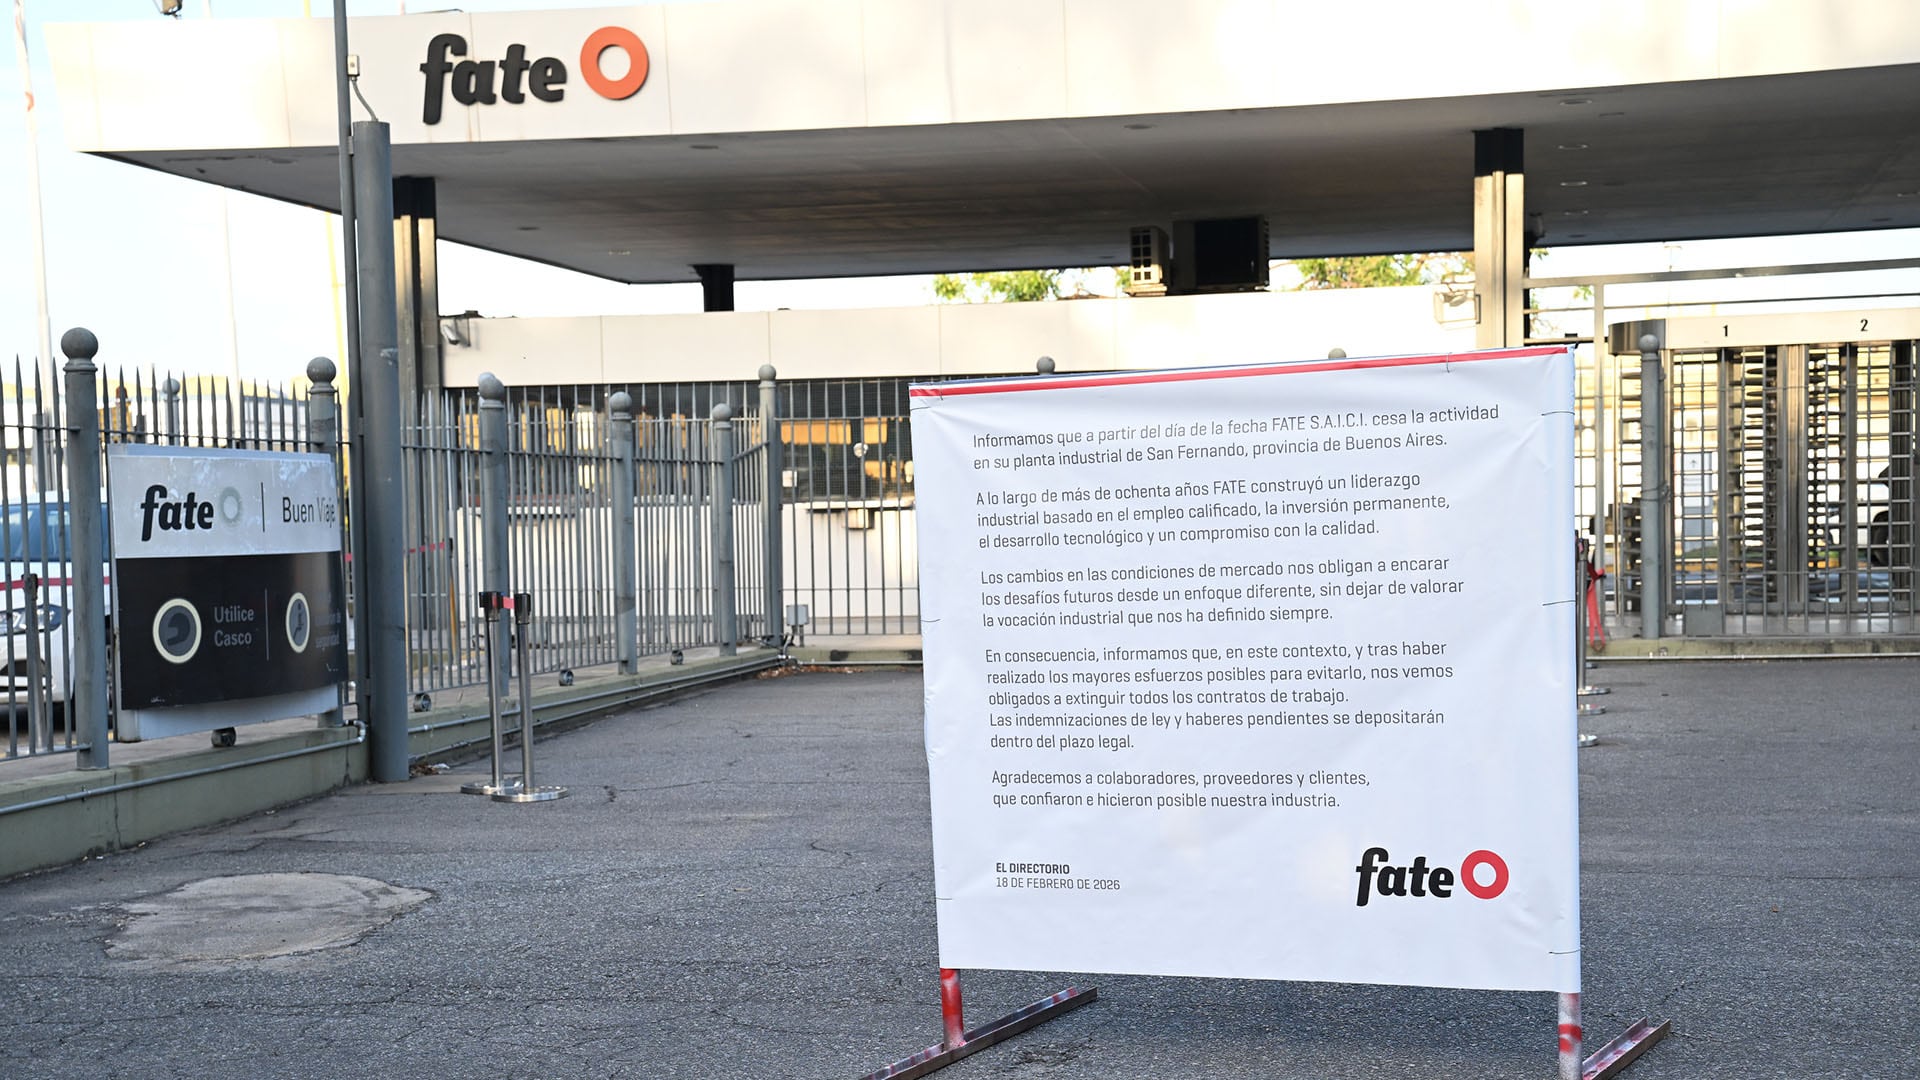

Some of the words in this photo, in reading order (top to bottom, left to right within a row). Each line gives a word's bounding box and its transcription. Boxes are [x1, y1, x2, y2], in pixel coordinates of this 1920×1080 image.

[420, 33, 567, 125] fate
[1722, 324, 1729, 337] 1
[1860, 319, 1869, 332] 2
[973, 433, 1054, 448] Informamos
[1057, 432, 1082, 447] que
[1086, 431, 1094, 442] a
[1098, 426, 1136, 445] partir
[1140, 424, 1160, 439] del
[1165, 423, 1186, 438] día
[1190, 422, 1207, 436] de
[1211, 421, 1223, 435] la
[1228, 418, 1268, 434] fecha
[1272, 416, 1305, 432] FATE
[1310, 412, 1368, 430] S.A.I.C.I.
[1372, 413, 1407, 426] cesa
[1411, 409, 1424, 424] la
[1429, 404, 1499, 423] actividad
[974, 458, 990, 470] en
[994, 458, 1010, 469] su
[1013, 453, 1055, 471] planta
[1058, 448, 1122, 465] industrial
[1126, 447, 1143, 462] de
[1146, 446, 1174, 461] San
[1178, 442, 1248, 460] Fernando,
[1252, 438, 1318, 459] provincia
[1323, 437, 1341, 452] de
[1345, 436, 1402, 451] Buenos
[1405, 432, 1447, 447] Aires.
[976, 492, 985, 506] A
[987, 491, 999, 505] lo
[1002, 490, 1037, 508] largo
[1041, 488, 1058, 503] de
[1061, 487, 1091, 502] más
[1094, 486, 1111, 501] de
[1114, 484, 1171, 500] ochenta
[1175, 482, 1209, 497] años
[1213, 479, 1247, 495] FATE
[1250, 475, 1324, 495] construyó
[1328, 478, 1346, 490] un
[1351, 473, 1420, 490] liderazgo
[140, 484, 214, 542] fate
[282, 496, 314, 523] Buen
[316, 497, 336, 528] Viaje
[977, 511, 1039, 527] industrial
[1043, 508, 1093, 524] basado
[1096, 511, 1113, 522] en
[1117, 506, 1129, 522] el
[1133, 505, 1184, 524] empleo
[1188, 501, 1261, 519] calificado,
[1265, 500, 1278, 515] la
[1282, 498, 1349, 515] inversión
[1353, 495, 1450, 516] permanente,
[979, 534, 990, 549] el
[993, 532, 1060, 548] desarrollo
[1063, 529, 1144, 548] tecnológico
[1146, 531, 1155, 546] y
[1158, 530, 1176, 542] un
[1180, 524, 1270, 544] compromiso
[1274, 526, 1300, 538] con
[1304, 522, 1317, 536] la
[1322, 519, 1380, 536] calidad.
[981, 571, 1004, 584] Los
[1006, 568, 1064, 584] cambios
[1067, 570, 1084, 582] en
[1087, 567, 1108, 581] las
[1111, 564, 1195, 581] condiciones
[1198, 563, 1216, 578] de
[1220, 561, 1284, 577] mercado
[1288, 563, 1314, 575] nos
[1318, 558, 1373, 577] obligan
[1377, 560, 1386, 572] a
[1390, 558, 1450, 572] encarar
[982, 592, 1001, 606] los
[1004, 590, 1060, 606] desafíos
[1063, 589, 1114, 604] futuros
[1117, 587, 1159, 602] desde
[1162, 590, 1180, 601] un
[1184, 585, 1242, 603] enfoque
[1246, 583, 1316, 599] diferente,
[1320, 581, 1342, 597] sin
[1346, 580, 1384, 600] dejar
[1388, 579, 1406, 595] de
[1410, 578, 1464, 594] valorar
[214, 605, 255, 623] Utilice
[982, 613, 994, 627] la
[997, 612, 1056, 627] vocación
[1059, 610, 1124, 626] industrial
[1128, 612, 1153, 628] que
[1157, 612, 1183, 623] nos
[1186, 608, 1204, 623] ha
[1208, 606, 1266, 622] definido
[1269, 606, 1333, 623] siempre.
[214, 629, 252, 647] Casco
[985, 649, 1001, 663] En
[1004, 647, 1099, 663] consecuencia,
[1103, 646, 1188, 661] informamos
[1192, 648, 1222, 663] que,
[1226, 648, 1243, 659] en
[1247, 645, 1278, 659] este
[1282, 644, 1351, 659] contexto,
[1354, 646, 1364, 660] y
[1367, 643, 1398, 657] tras
[1402, 640, 1447, 656] haber
[987, 670, 1045, 684] realizado
[1048, 669, 1069, 684] los
[1072, 672, 1131, 687] mayores
[1134, 667, 1203, 683] esfuerzos
[1207, 666, 1266, 685] posibles
[1270, 669, 1302, 684] para
[1306, 664, 1366, 681] evitarlo,
[1370, 667, 1399, 679] nos
[1402, 666, 1454, 678] vemos
[988, 691, 1051, 709] obligados
[1054, 694, 1062, 706] a
[1065, 690, 1126, 709] extinguir
[1128, 690, 1169, 705] todos
[1172, 690, 1193, 704] los
[1196, 690, 1266, 704] contratos
[1270, 688, 1288, 704] de
[1291, 687, 1349, 706] trabajo.
[990, 713, 1012, 727] Las
[1015, 712, 1128, 727] indemnizaciones
[1130, 712, 1148, 727] de
[1151, 712, 1171, 729] ley
[1174, 715, 1182, 730] y
[1186, 711, 1244, 726] haberes
[1247, 710, 1329, 729] pendientes
[1332, 713, 1350, 725] se
[1354, 708, 1444, 728] depositarán
[990, 734, 1033, 748] dentro
[1036, 734, 1056, 748] del
[1059, 734, 1095, 752] plazo
[1098, 734, 1134, 752] legal.
[992, 770, 1082, 788] Agradecemos
[1085, 773, 1093, 785] a
[1096, 770, 1199, 786] colaboradores,
[1203, 770, 1293, 789] proveedores
[1296, 774, 1305, 788] y
[1309, 770, 1370, 786] clientes,
[993, 794, 1017, 808] que
[1020, 791, 1083, 806] confiaron
[1086, 795, 1094, 806] e
[1097, 792, 1153, 807] hicieron
[1156, 792, 1207, 810] posible
[1210, 794, 1267, 807] nuestra
[1271, 792, 1340, 808] industria.
[996, 862, 1008, 873] EL
[1009, 862, 1070, 875] DIRECTORIO
[1356, 847, 1455, 907] fate
[996, 876, 1008, 888] 18
[1010, 877, 1024, 888] DE
[1026, 877, 1074, 890] FEBRERO
[1076, 878, 1091, 890] DE
[1092, 879, 1120, 890] 2026
